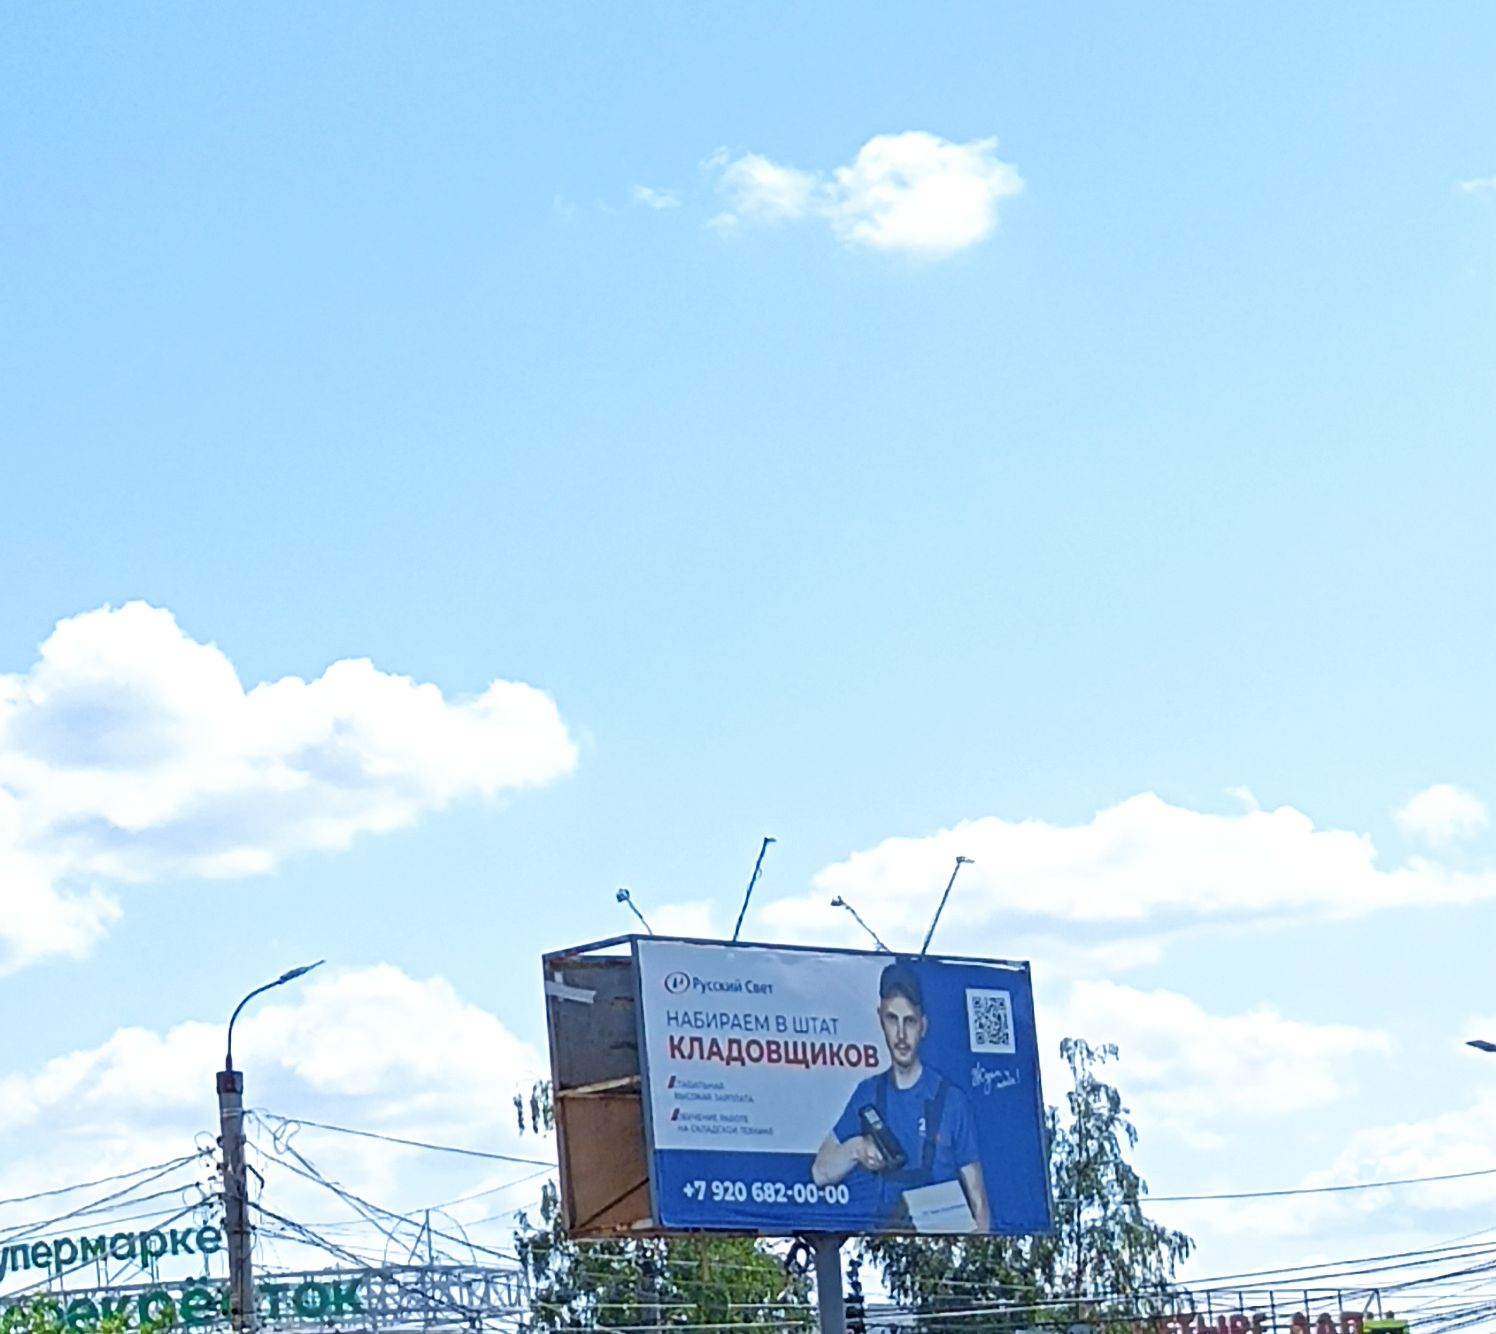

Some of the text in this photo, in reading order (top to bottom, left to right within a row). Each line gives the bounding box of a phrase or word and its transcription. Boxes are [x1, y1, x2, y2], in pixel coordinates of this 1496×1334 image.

[692, 976, 774, 994] Русский Свет
[666, 1009, 840, 1035] НАБИРАЕМ В ШТАТ
[668, 1034, 880, 1069] КЛАДОВЩИКОВ
[682, 1180, 850, 1204] +7 920 682-00-00
